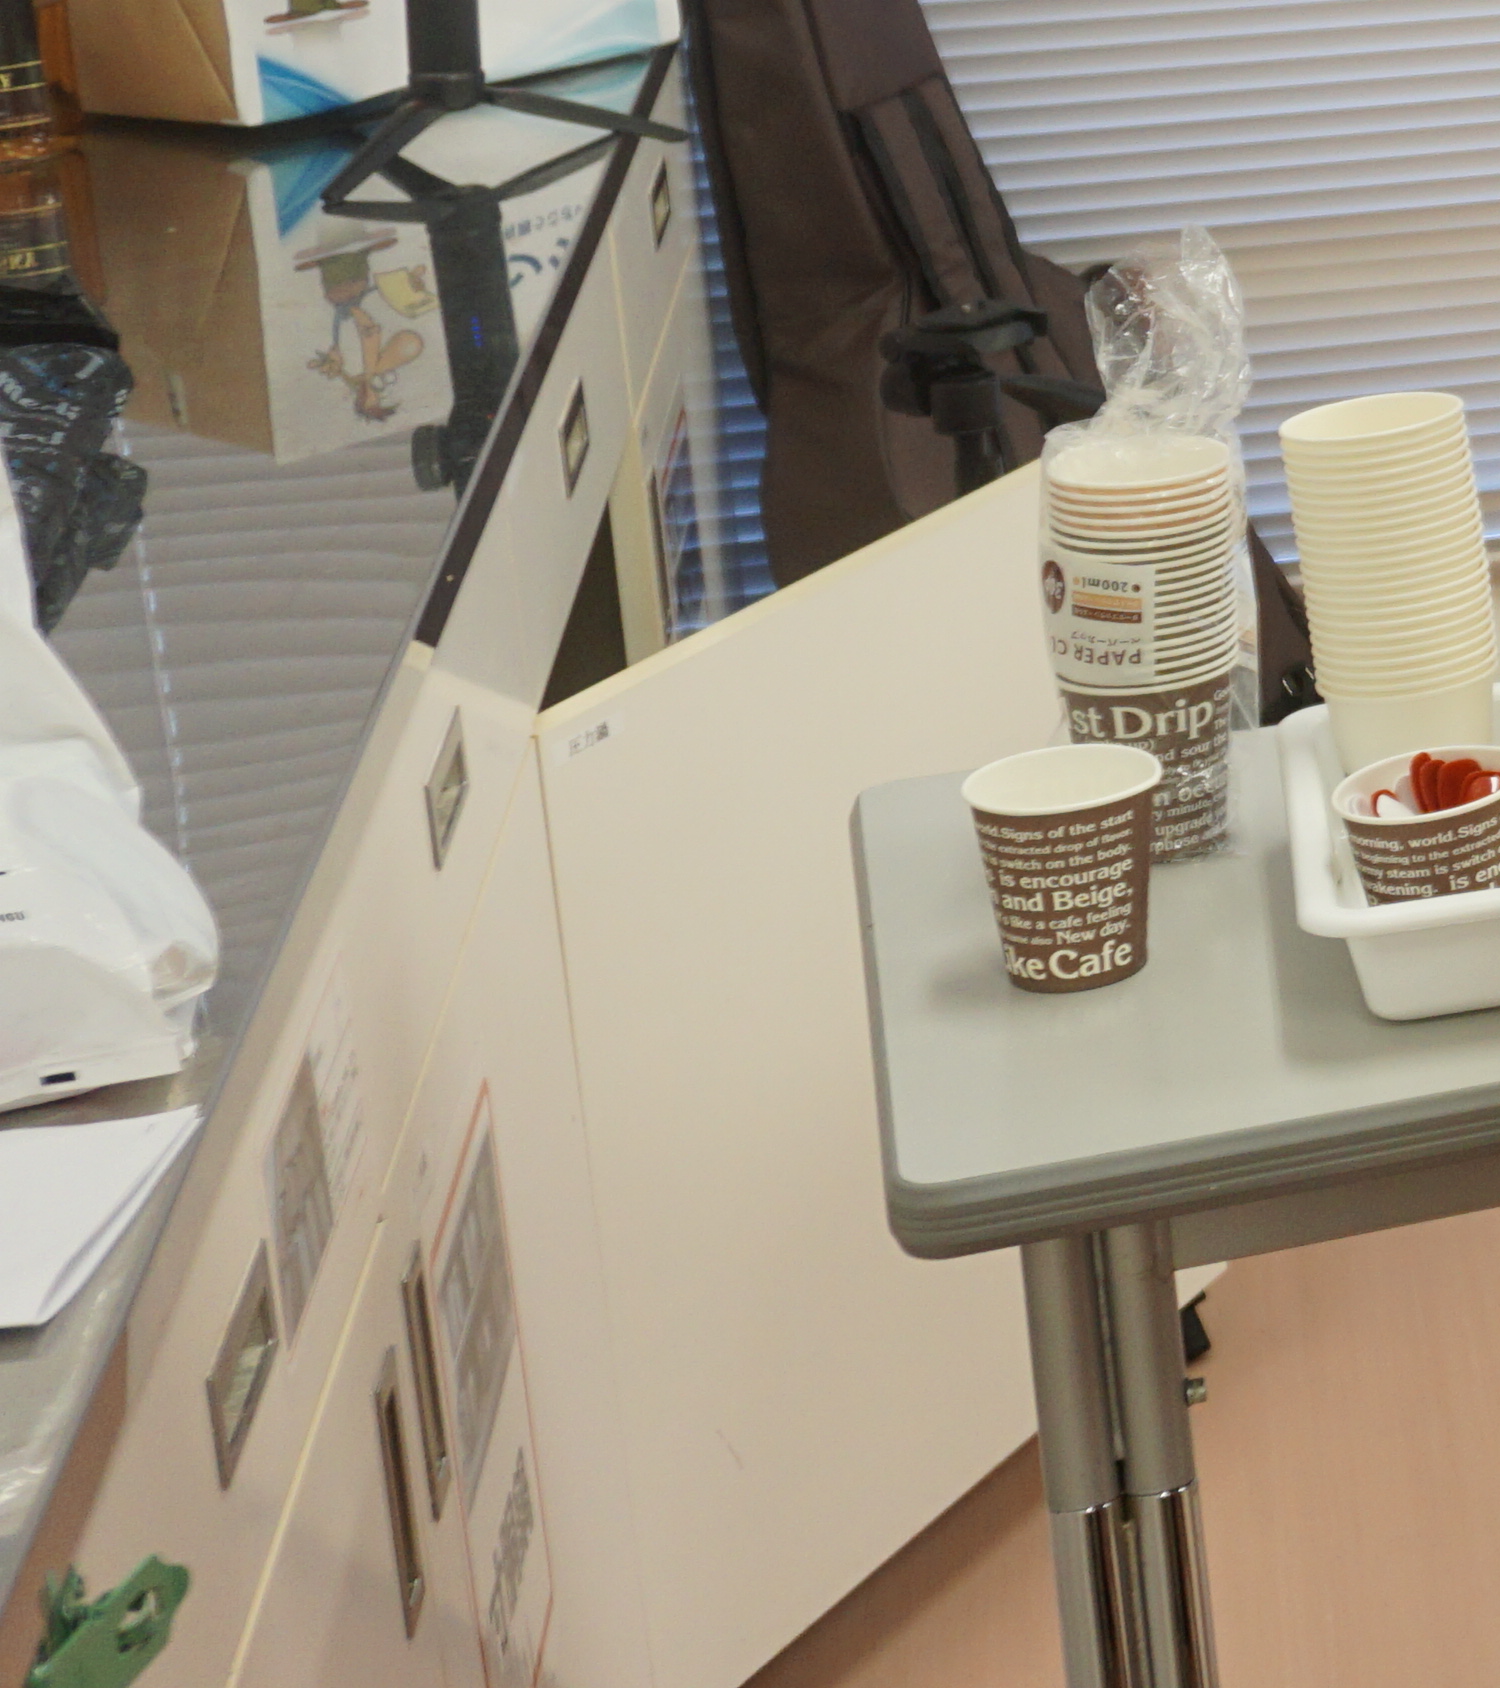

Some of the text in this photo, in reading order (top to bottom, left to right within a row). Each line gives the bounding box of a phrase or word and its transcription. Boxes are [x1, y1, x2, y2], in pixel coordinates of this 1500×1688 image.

[1082, 577, 1129, 593] 200ml
[1073, 643, 1142, 666] PAPER
[1109, 698, 1214, 740] Drip
[1047, 826, 1066, 839] of
[1069, 821, 1097, 837] the
[1100, 810, 1134, 829] start
[1053, 841, 1084, 855] drop
[1411, 853, 1426, 863] to
[1429, 849, 1449, 861] the
[999, 858, 1133, 890] is encourage
[1045, 859, 1066, 871] on
[1069, 854, 1094, 868] the
[1386, 866, 1431, 879] steam
[1434, 864, 1449, 875] is
[1452, 849, 1496, 871] switch
[1001, 881, 1134, 912] and Beige,
[1364, 879, 1439, 898] akening.
[1449, 874, 1470, 891] is
[1049, 915, 1084, 931] cafe
[1086, 902, 1133, 925] feeling
[1056, 929, 1096, 946] New
[1049, 939, 1134, 980] Cafe
